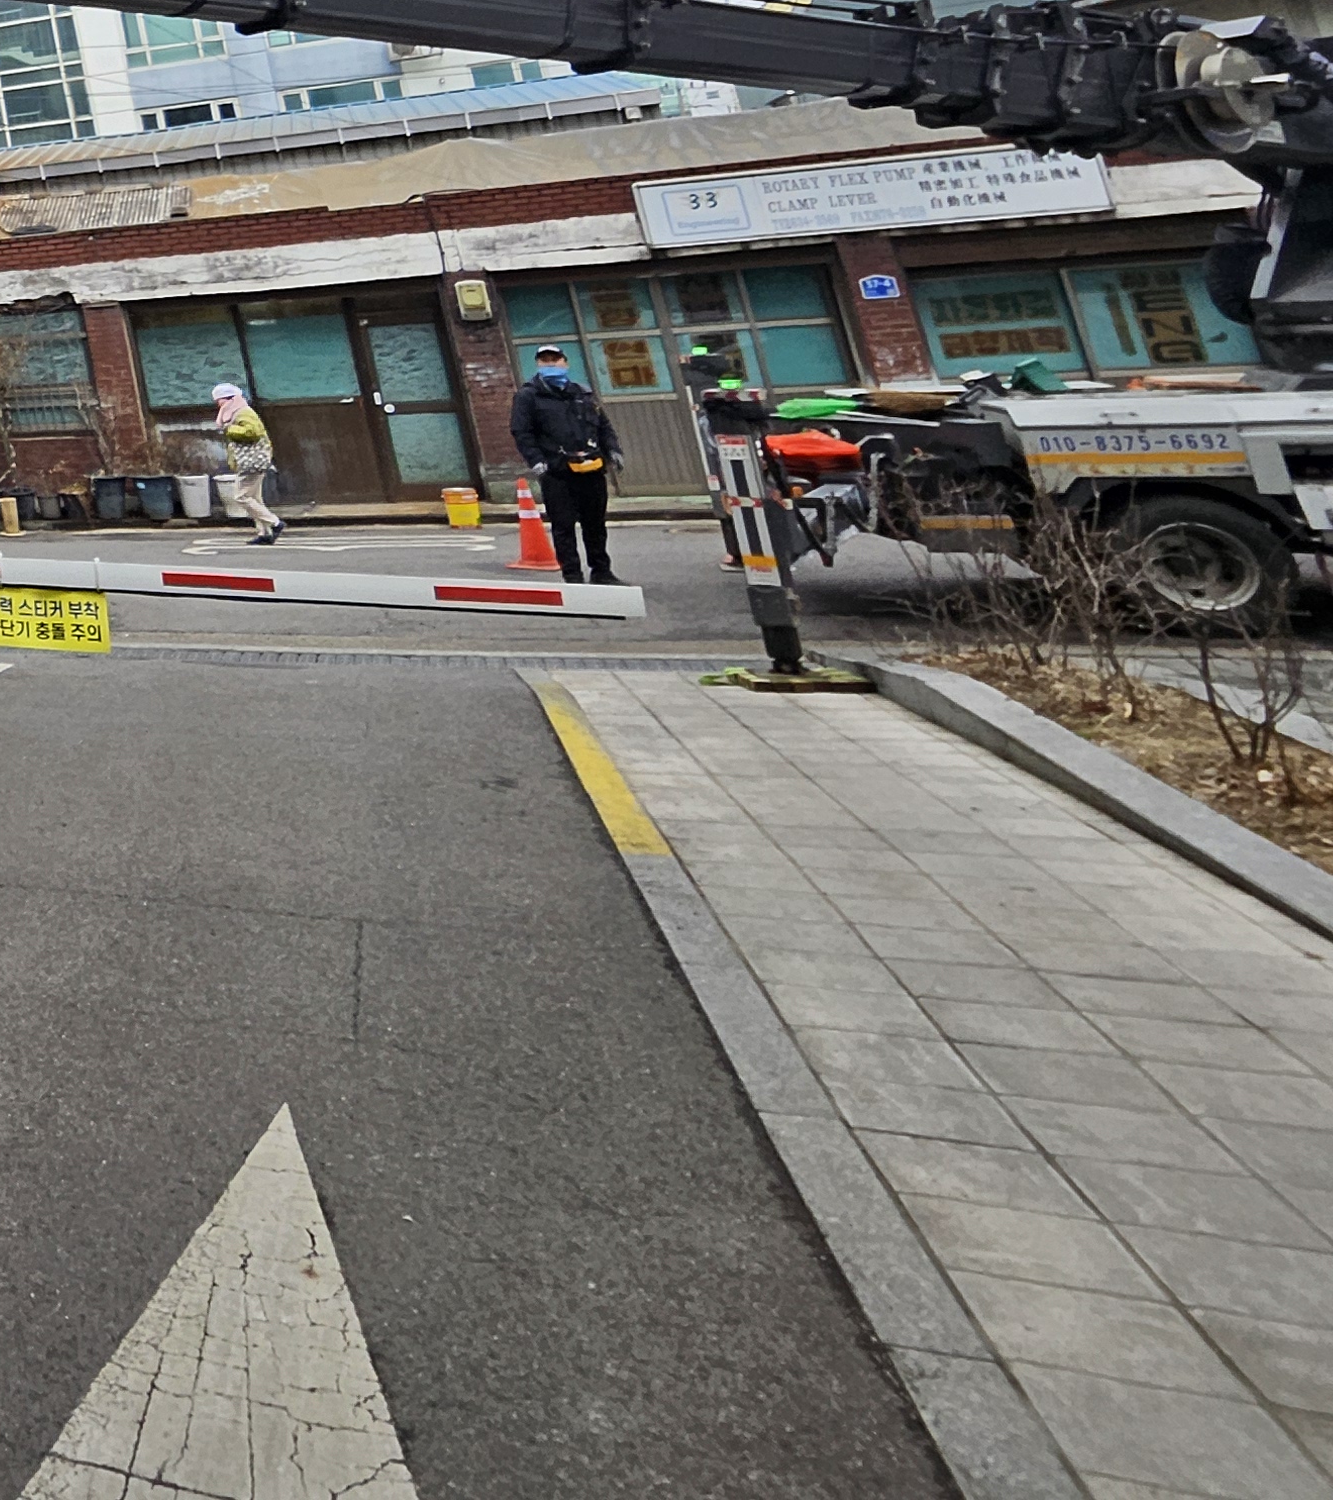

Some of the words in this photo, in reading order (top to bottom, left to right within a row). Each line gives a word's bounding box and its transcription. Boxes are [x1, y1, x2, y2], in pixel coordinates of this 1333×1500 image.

[761, 176, 820, 194] ROTARY
[828, 171, 869, 187] FLEX
[873, 167, 916, 183] PUMP
[767, 197, 818, 213] CLAMP
[828, 192, 878, 208] LEVER
[1039, 433, 1230, 452] 010-8375-6692
[18, 599, 63, 619] 스티커
[67, 600, 99, 620] 부착
[35, 621, 67, 641] 충돌
[70, 623, 102, 642] 주의
